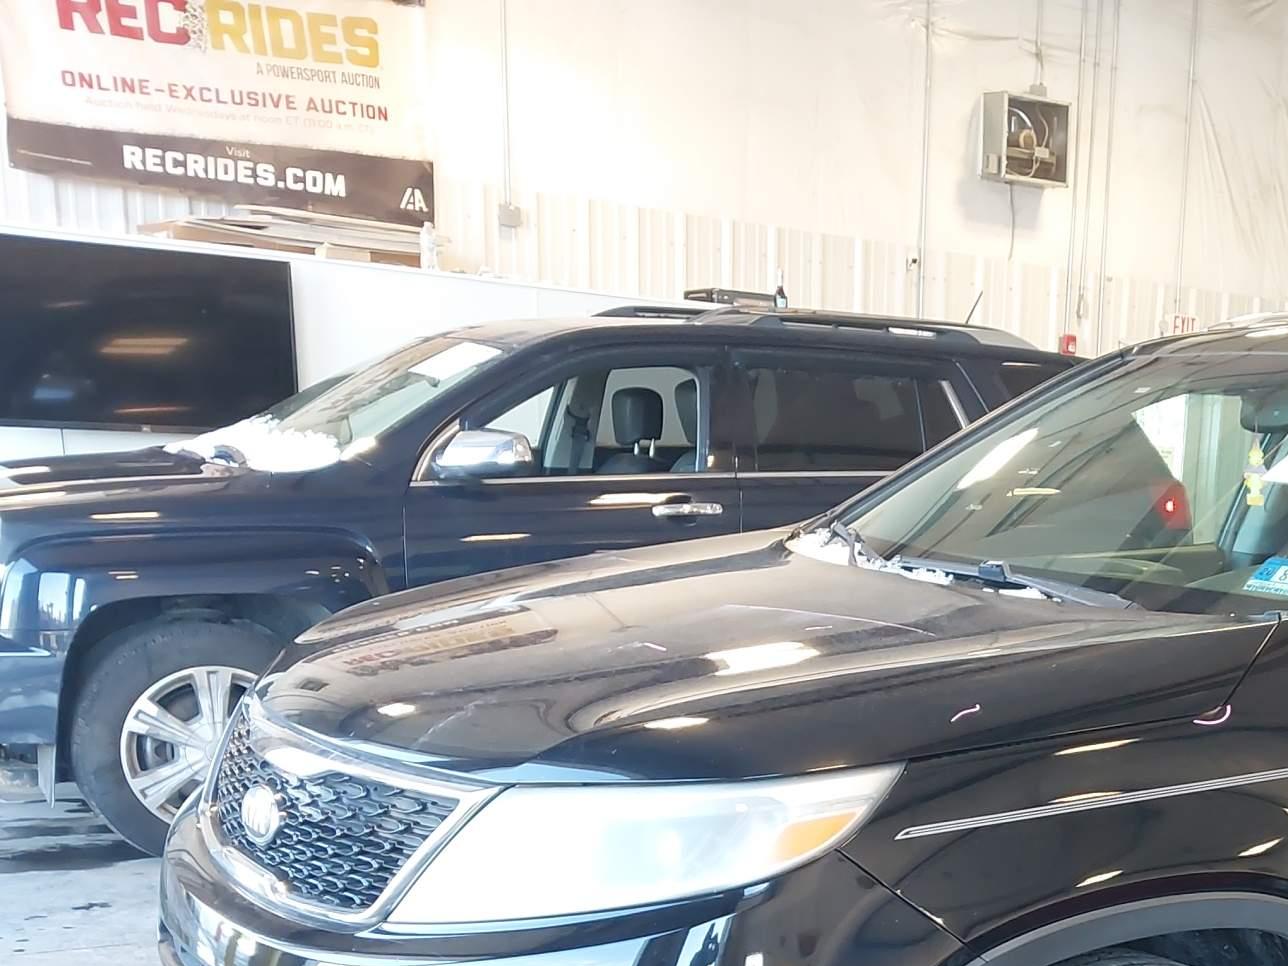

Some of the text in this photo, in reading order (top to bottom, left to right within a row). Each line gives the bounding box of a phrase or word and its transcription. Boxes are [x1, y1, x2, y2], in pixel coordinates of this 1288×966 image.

[55, 0, 381, 69] REC RIDES
[61, 69, 389, 122] ONLINE-EXCLUSIVE AUCTION
[256, 62, 381, 89] A POWERSPORT AUCTION
[123, 145, 347, 197] RECRIDES.COM
[225, 145, 251, 158] Visit
